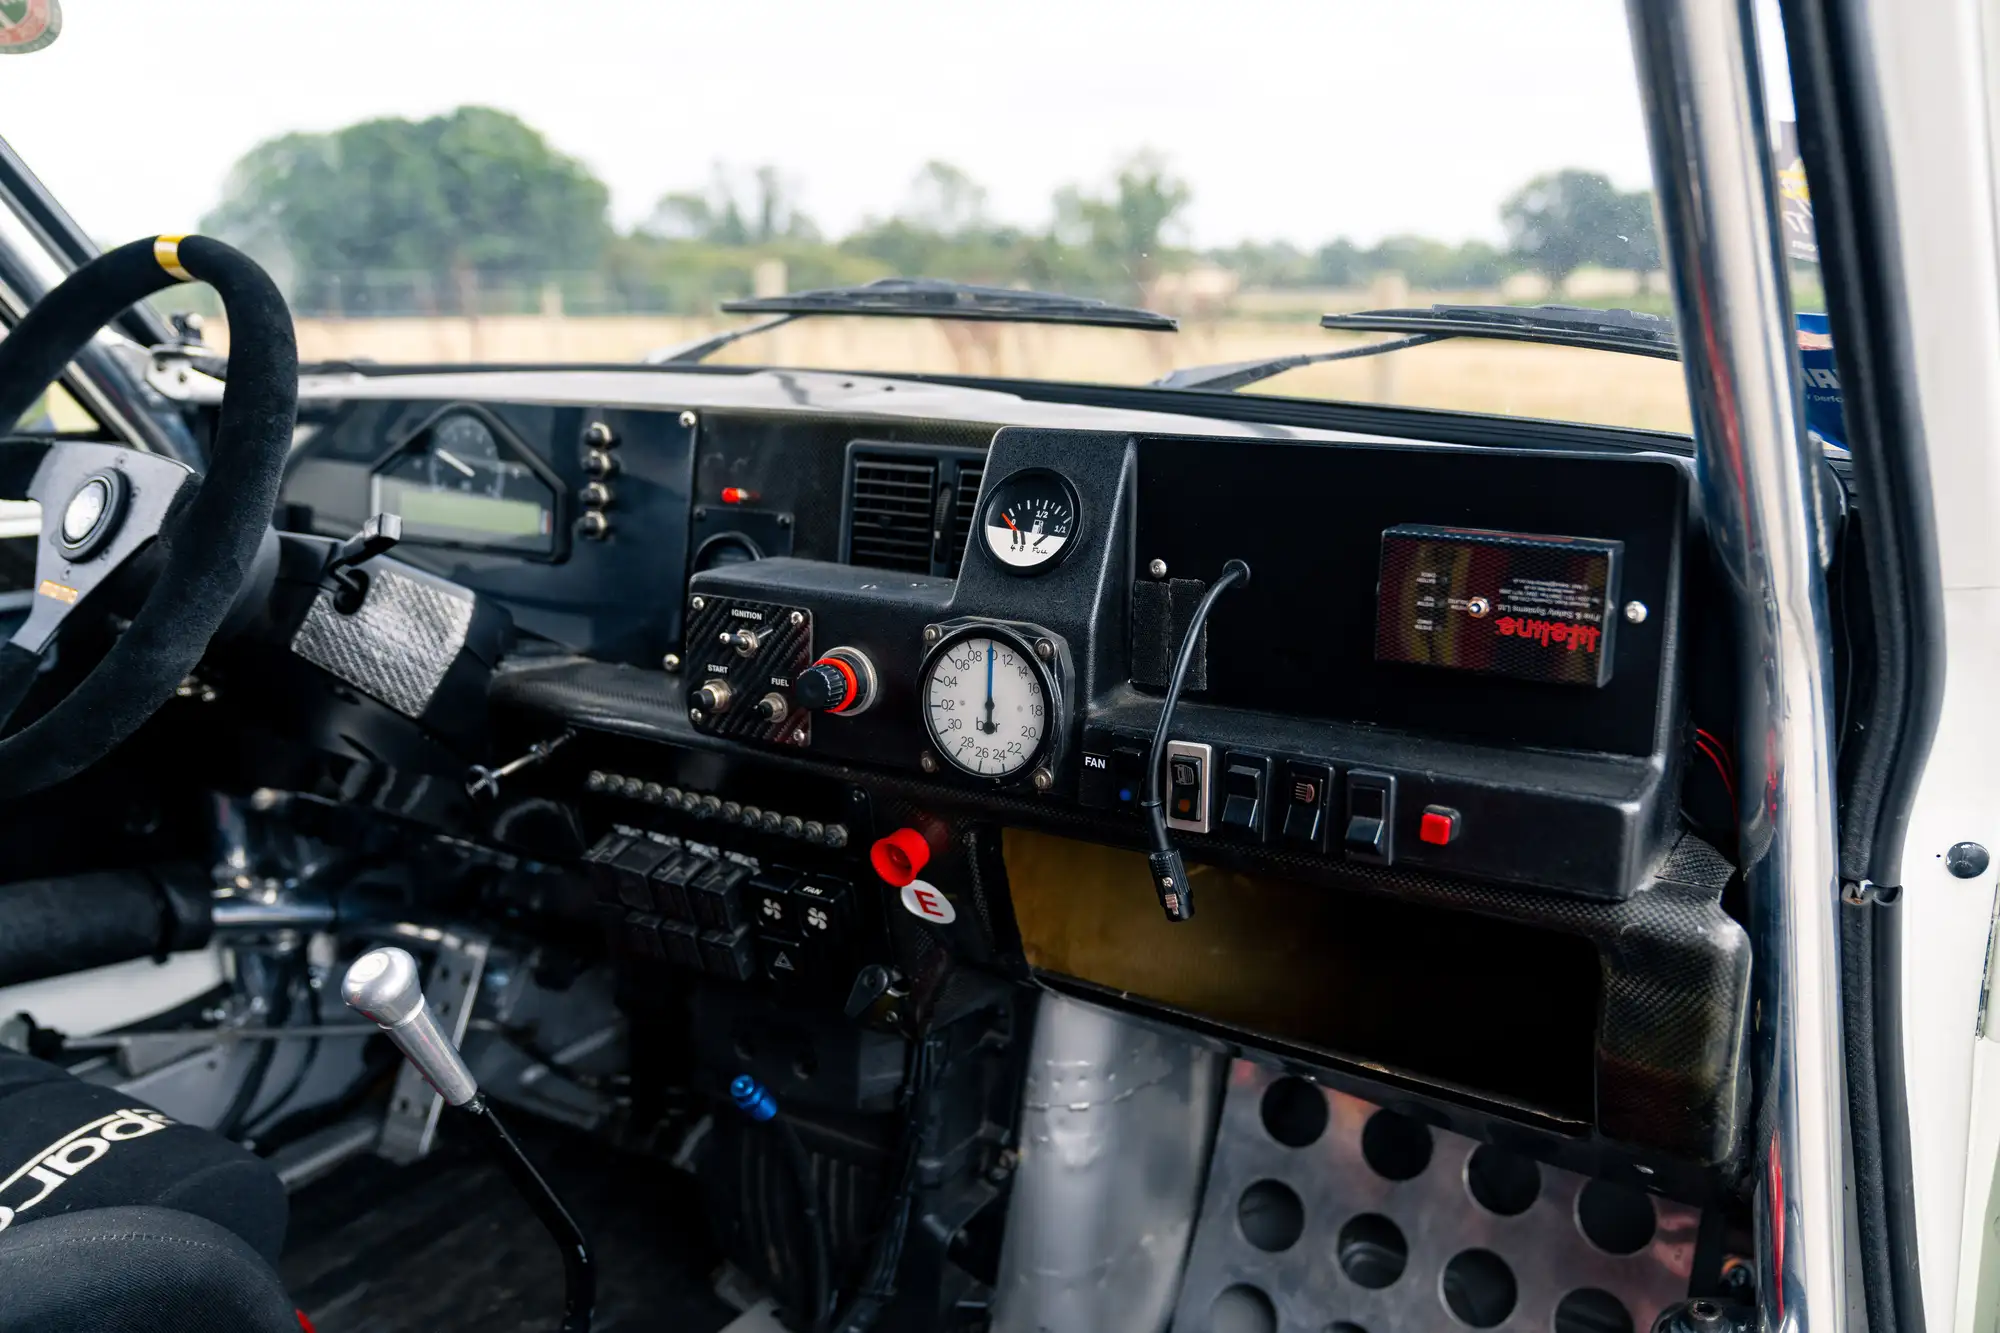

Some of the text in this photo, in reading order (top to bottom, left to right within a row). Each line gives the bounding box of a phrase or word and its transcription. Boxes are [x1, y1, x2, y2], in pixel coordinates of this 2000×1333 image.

[1035, 510, 1049, 519] 1/2
[1054, 524, 1066, 534] 1/1
[731, 608, 763, 621] IGNITION
[1512, 605, 1546, 617] Systems
[707, 663, 728, 674] START
[771, 677, 789, 687] FUEL
[975, 717, 1000, 732] br
[1085, 756, 1106, 769] FAN
[802, 885, 823, 895] FAN
[913, 889, 945, 917] E
